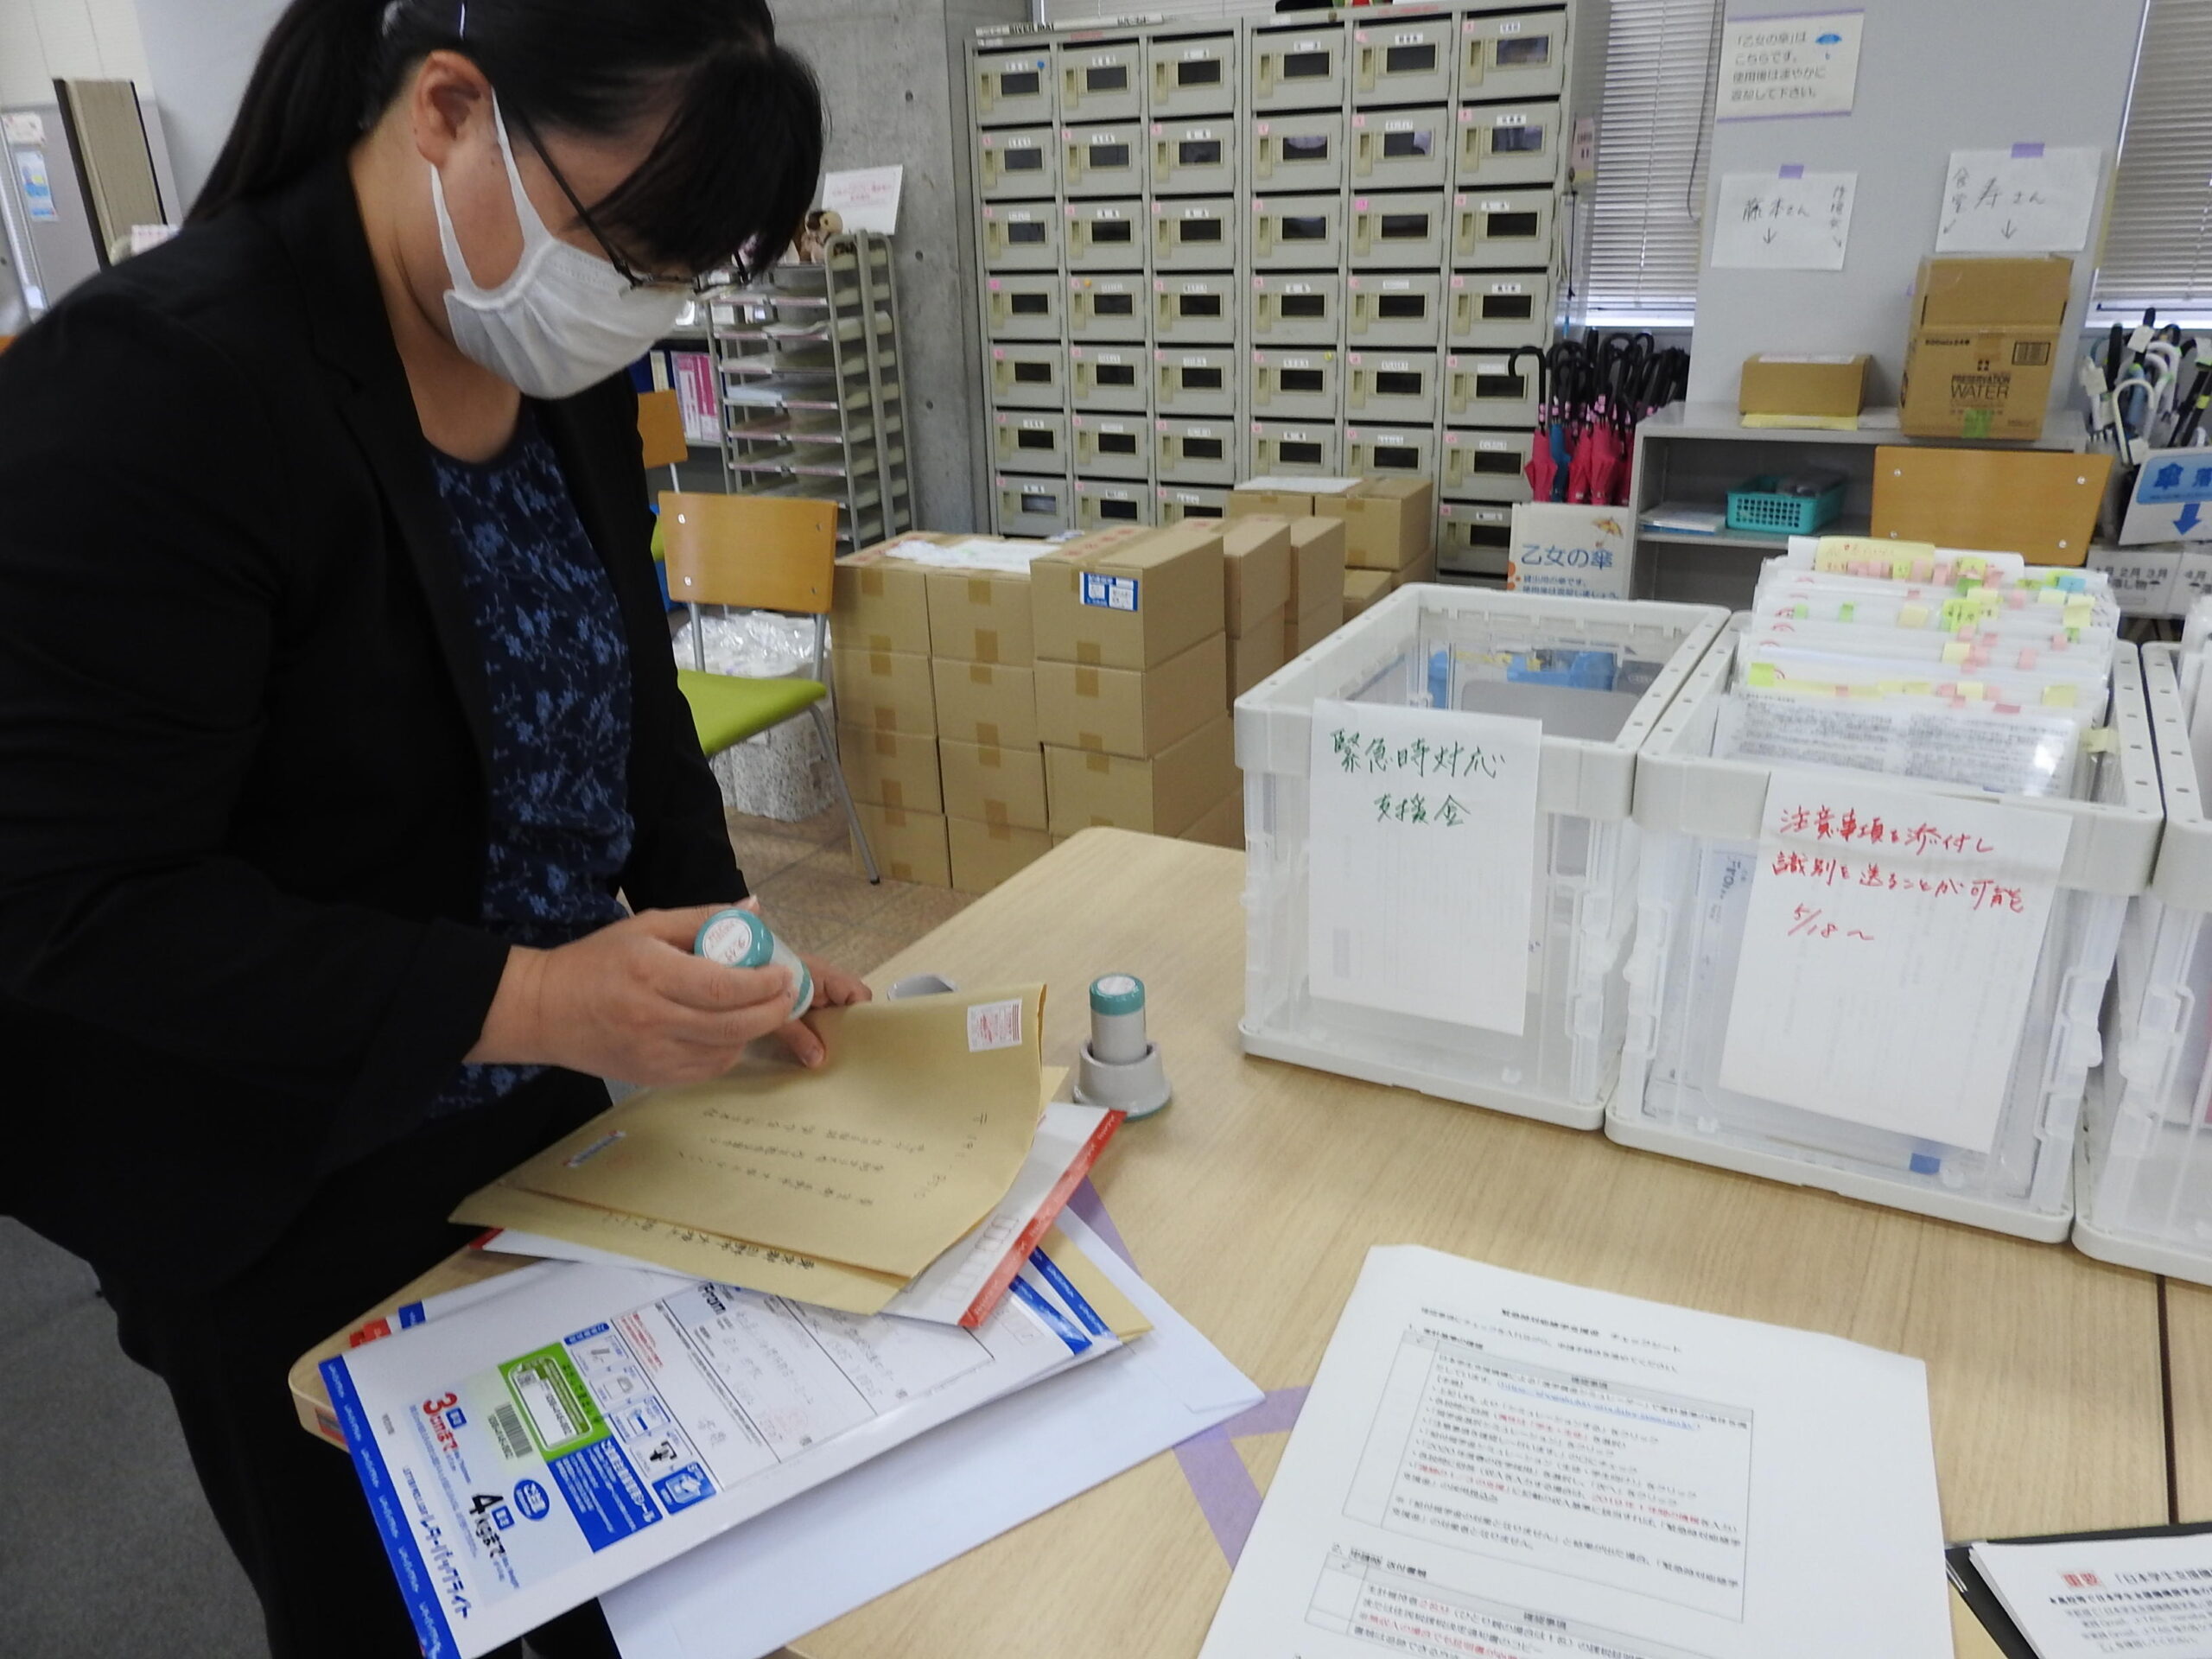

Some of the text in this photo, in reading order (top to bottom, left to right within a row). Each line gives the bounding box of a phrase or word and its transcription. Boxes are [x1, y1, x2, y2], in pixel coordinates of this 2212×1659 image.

[1951, 385, 2010, 400] WATER
[1952, 372, 2012, 385] PRESERVATION
[1521, 544, 1613, 570] 乙女の傘
[1330, 728, 1506, 779] 緊急時対応
[1374, 794, 1471, 826] 支援金
[701, 1281, 728, 1316] From
